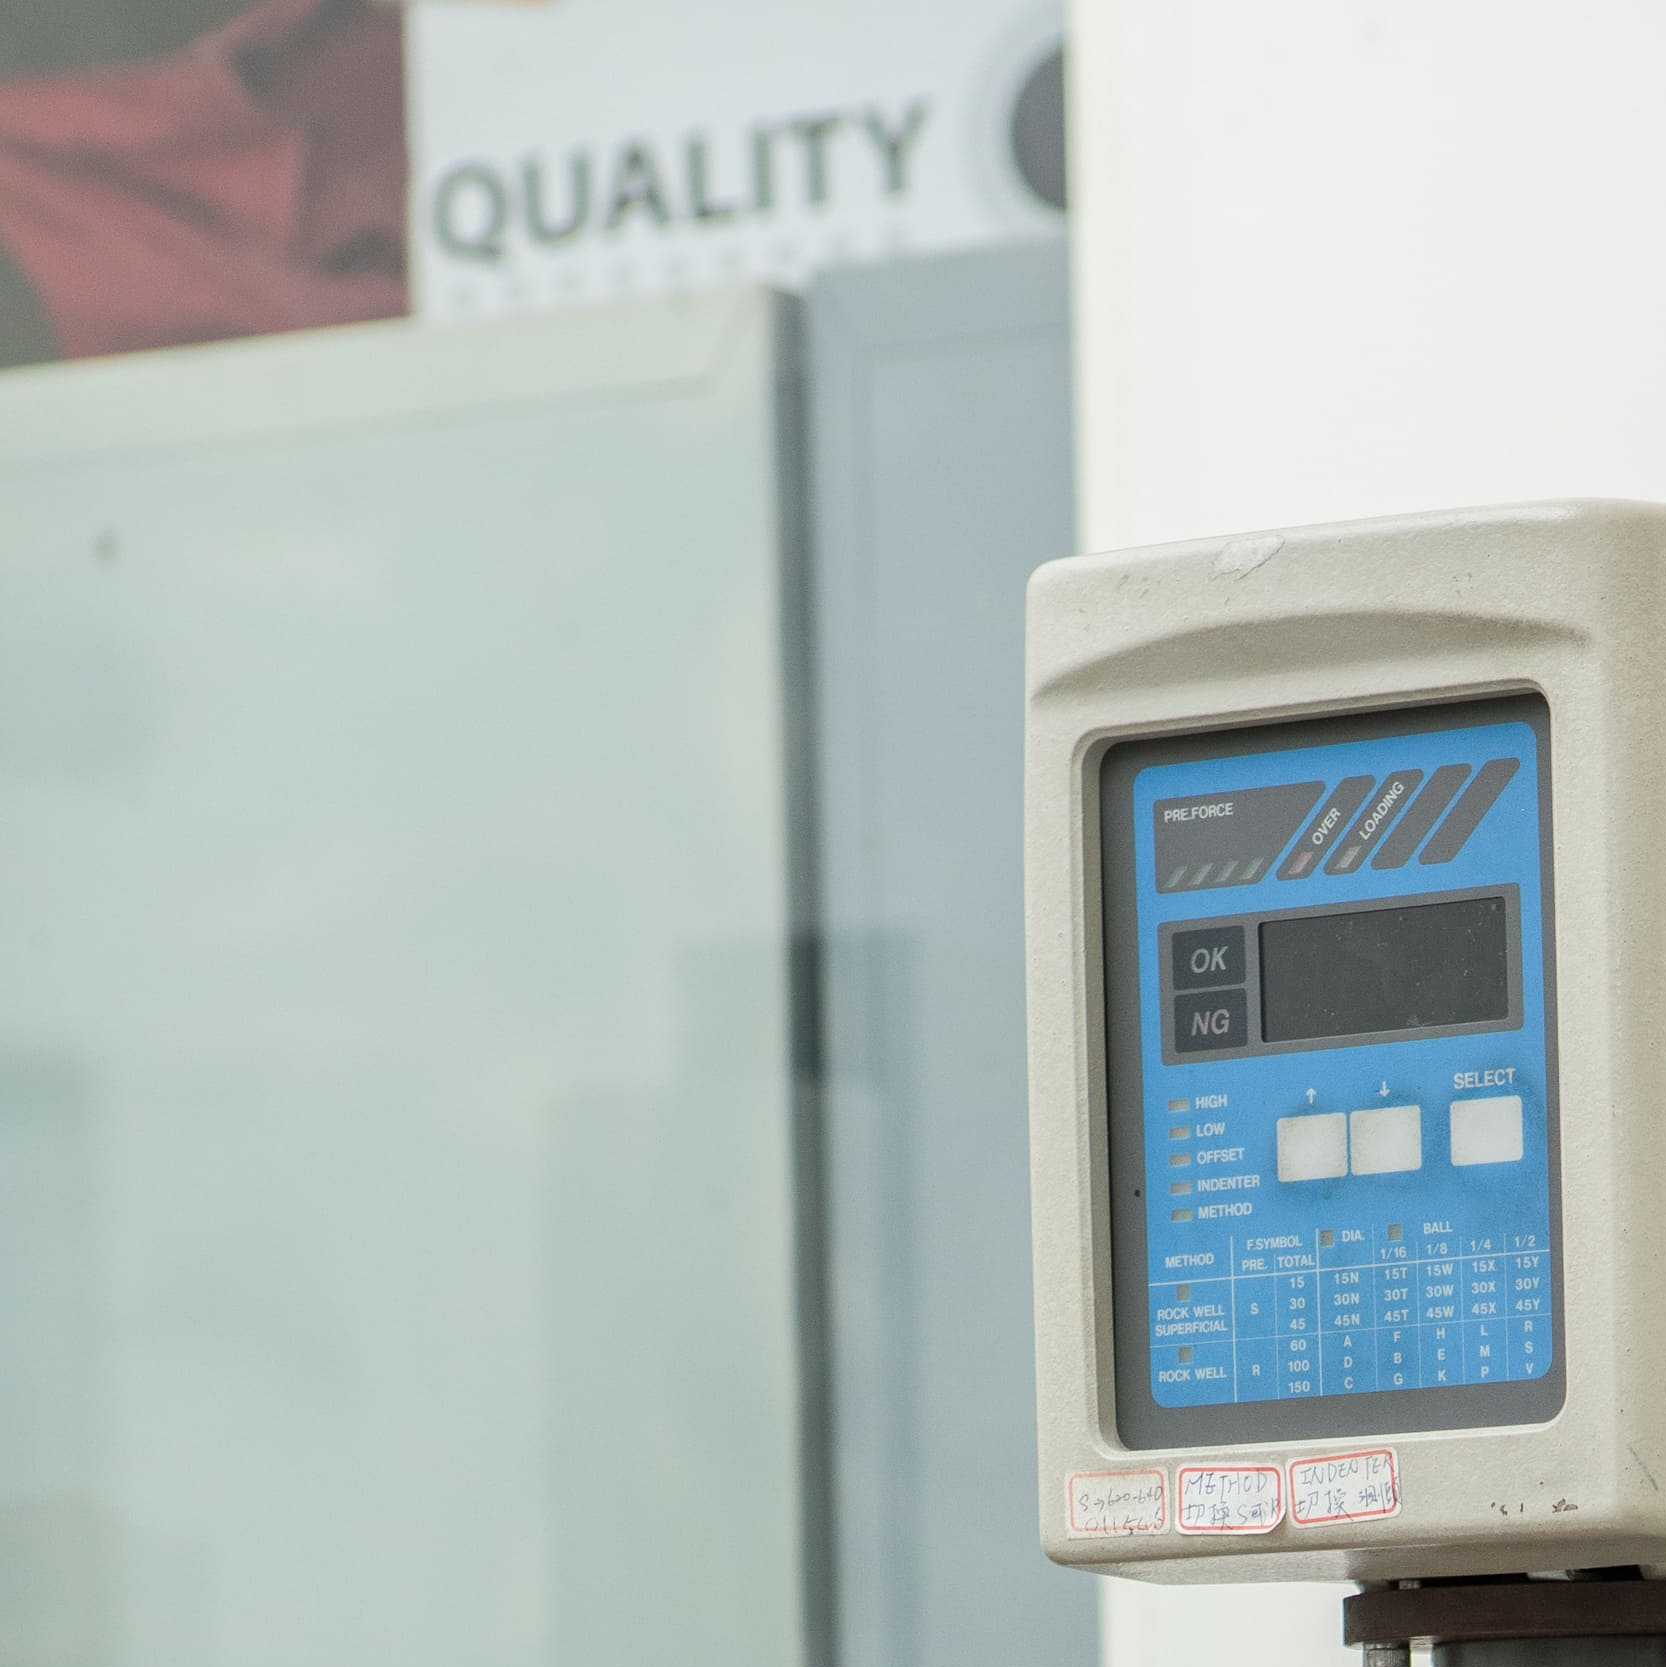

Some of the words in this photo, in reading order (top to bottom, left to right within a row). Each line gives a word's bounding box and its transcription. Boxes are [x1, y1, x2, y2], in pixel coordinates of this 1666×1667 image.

[430, 90, 932, 262] QUALITY
[1163, 803, 1234, 823] PRE.FORCE
[1358, 781, 1405, 841] LOADING
[1311, 807, 1342, 845] OVER
[1190, 944, 1229, 975] OK
[1190, 1007, 1231, 1037] NG
[1453, 1068, 1516, 1091] SELECT
[1195, 1095, 1228, 1110] HIGH
[1196, 1123, 1225, 1137] LOW
[1197, 1148, 1245, 1165] OFFSET
[1197, 1175, 1260, 1193] INDENTER
[1198, 1203, 1252, 1220] METHOD
[1246, 1235, 1303, 1250] F.SYMBOL
[1342, 1230, 1365, 1242] DIA.
[1423, 1221, 1453, 1235] BALL
[1165, 1253, 1214, 1268] METHOD
[1242, 1259, 1268, 1271] PRE.
[1277, 1254, 1315, 1268] TOTAL
[1380, 1246, 1407, 1259] 1/16
[1426, 1243, 1448, 1255] 1/8
[1470, 1238, 1492, 1251] 1/4
[1514, 1235, 1536, 1248] 1/2
[1290, 1276, 1304, 1288] 15
[1333, 1272, 1359, 1285] 15N
[1384, 1267, 1408, 1280] 15T
[1426, 1263, 1453, 1277] 15W
[1471, 1260, 1496, 1273] 15X
[1515, 1256, 1540, 1269] 15Y
[1289, 1298, 1305, 1310] 30
[1333, 1293, 1360, 1306] 30N
[1384, 1288, 1408, 1301] 30T
[1425, 1284, 1454, 1298] 30W
[1471, 1281, 1496, 1294] 30X
[1515, 1277, 1540, 1291] 30Y
[1157, 1306, 1189, 1321] ROCK
[1193, 1304, 1225, 1317] WELL
[1250, 1303, 1259, 1315] S
[1290, 1318, 1306, 1330] 45
[1334, 1313, 1360, 1327] 45N
[1384, 1309, 1409, 1322] 45T
[1426, 1305, 1455, 1319] 45W
[1471, 1301, 1496, 1315] 45X
[1515, 1298, 1541, 1312] 45Y
[1155, 1320, 1229, 1337] SUPERFICIAL
[1290, 1340, 1307, 1351] 60
[1343, 1335, 1352, 1348] A
[1393, 1331, 1401, 1344] F
[1436, 1327, 1445, 1340] H
[1480, 1324, 1488, 1336] L
[1524, 1320, 1533, 1332] R
[1288, 1360, 1310, 1372] 100
[1344, 1356, 1352, 1368] D
[1393, 1353, 1402, 1365] B
[1437, 1349, 1446, 1361] E
[1480, 1345, 1490, 1357] M
[1524, 1341, 1533, 1354] S
[1158, 1369, 1190, 1383] ROCK
[1195, 1366, 1227, 1380] WELL
[1252, 1364, 1261, 1376] R
[1288, 1381, 1310, 1393] 150
[1344, 1376, 1353, 1389] C
[1393, 1373, 1403, 1386] G
[1438, 1370, 1447, 1382] K
[1481, 1366, 1489, 1378] P
[1525, 1363, 1534, 1375] V
[1184, 1472, 1267, 1499] METHOD
